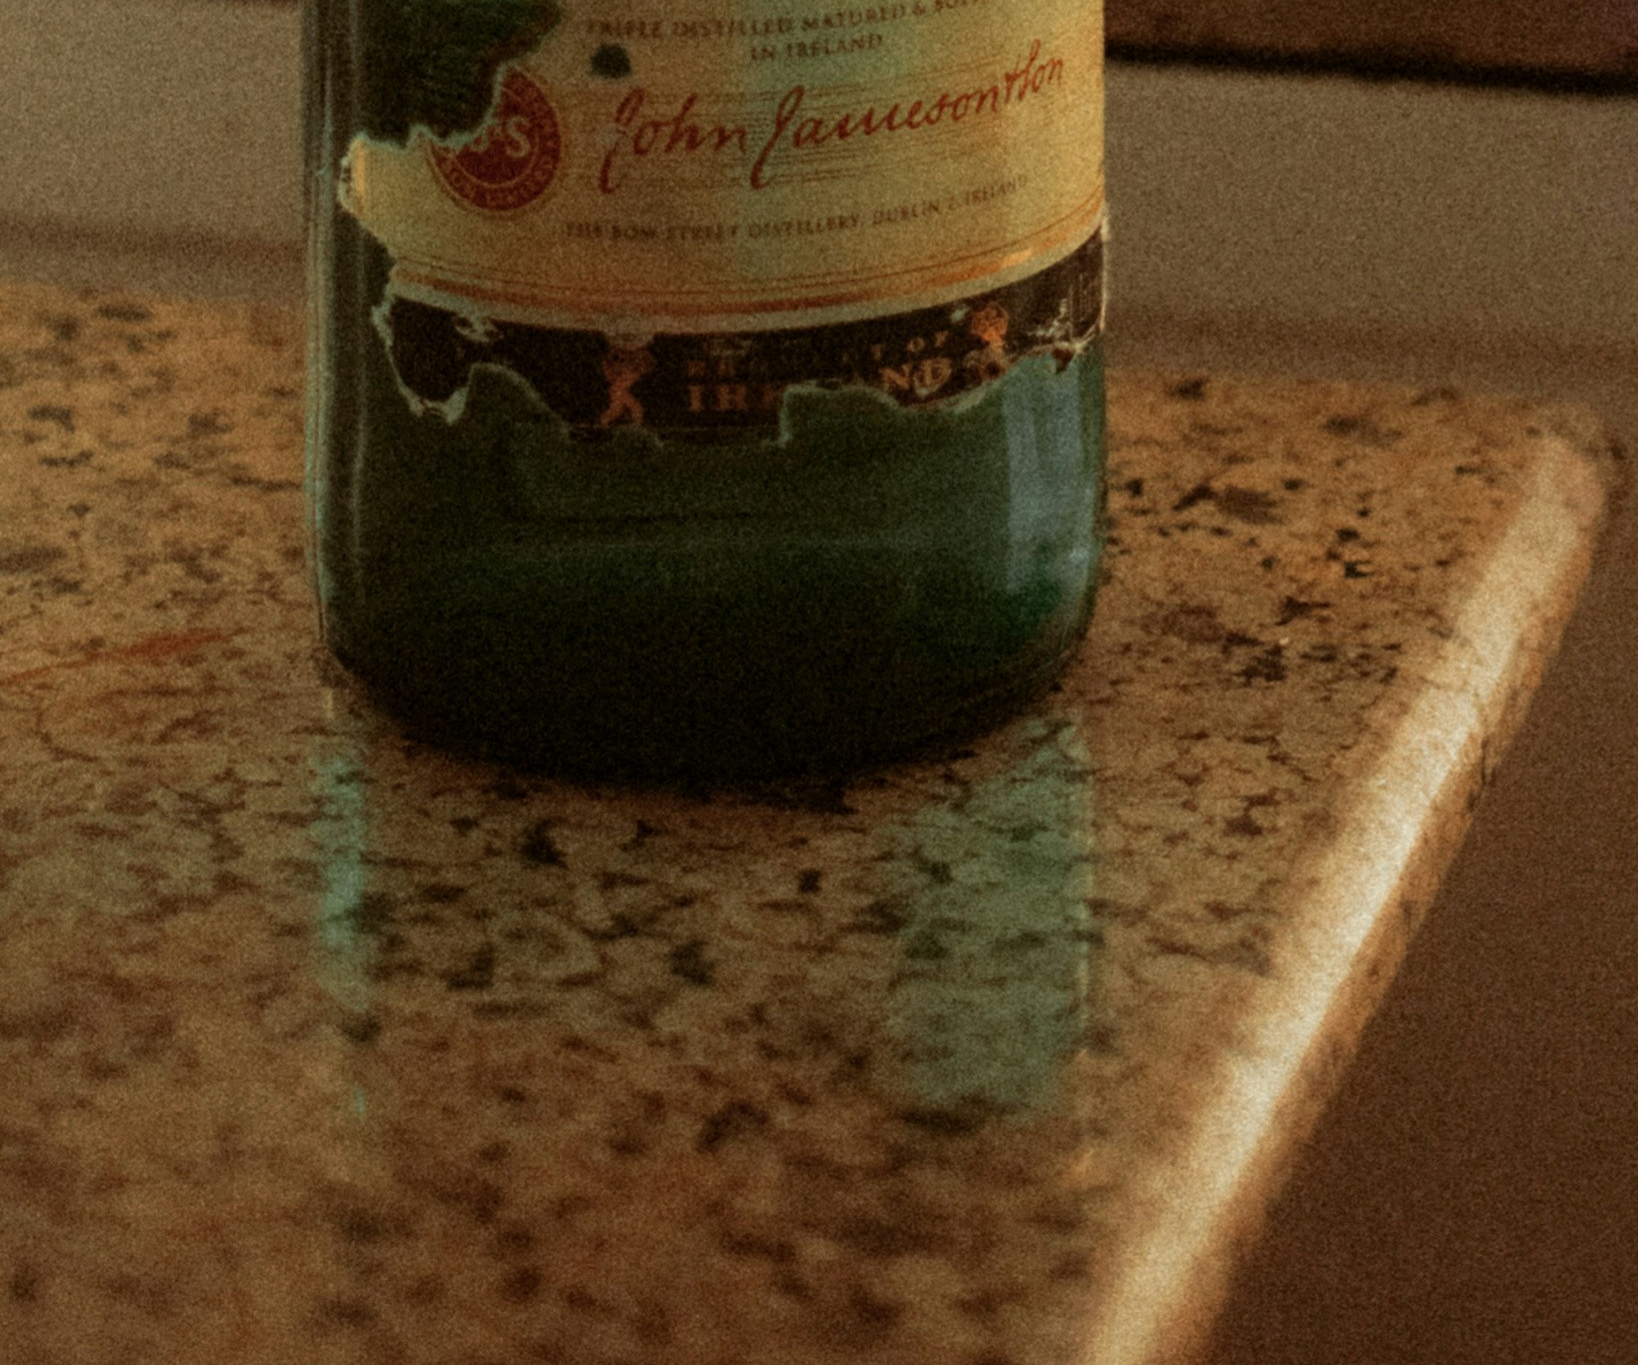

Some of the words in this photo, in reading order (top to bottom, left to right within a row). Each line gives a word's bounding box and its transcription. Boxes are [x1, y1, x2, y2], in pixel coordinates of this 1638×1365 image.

[800, 3, 906, 32] MATURED
[786, 33, 883, 59] IRELAND
[598, 86, 747, 195] John
[748, 83, 1000, 191] Jameson
